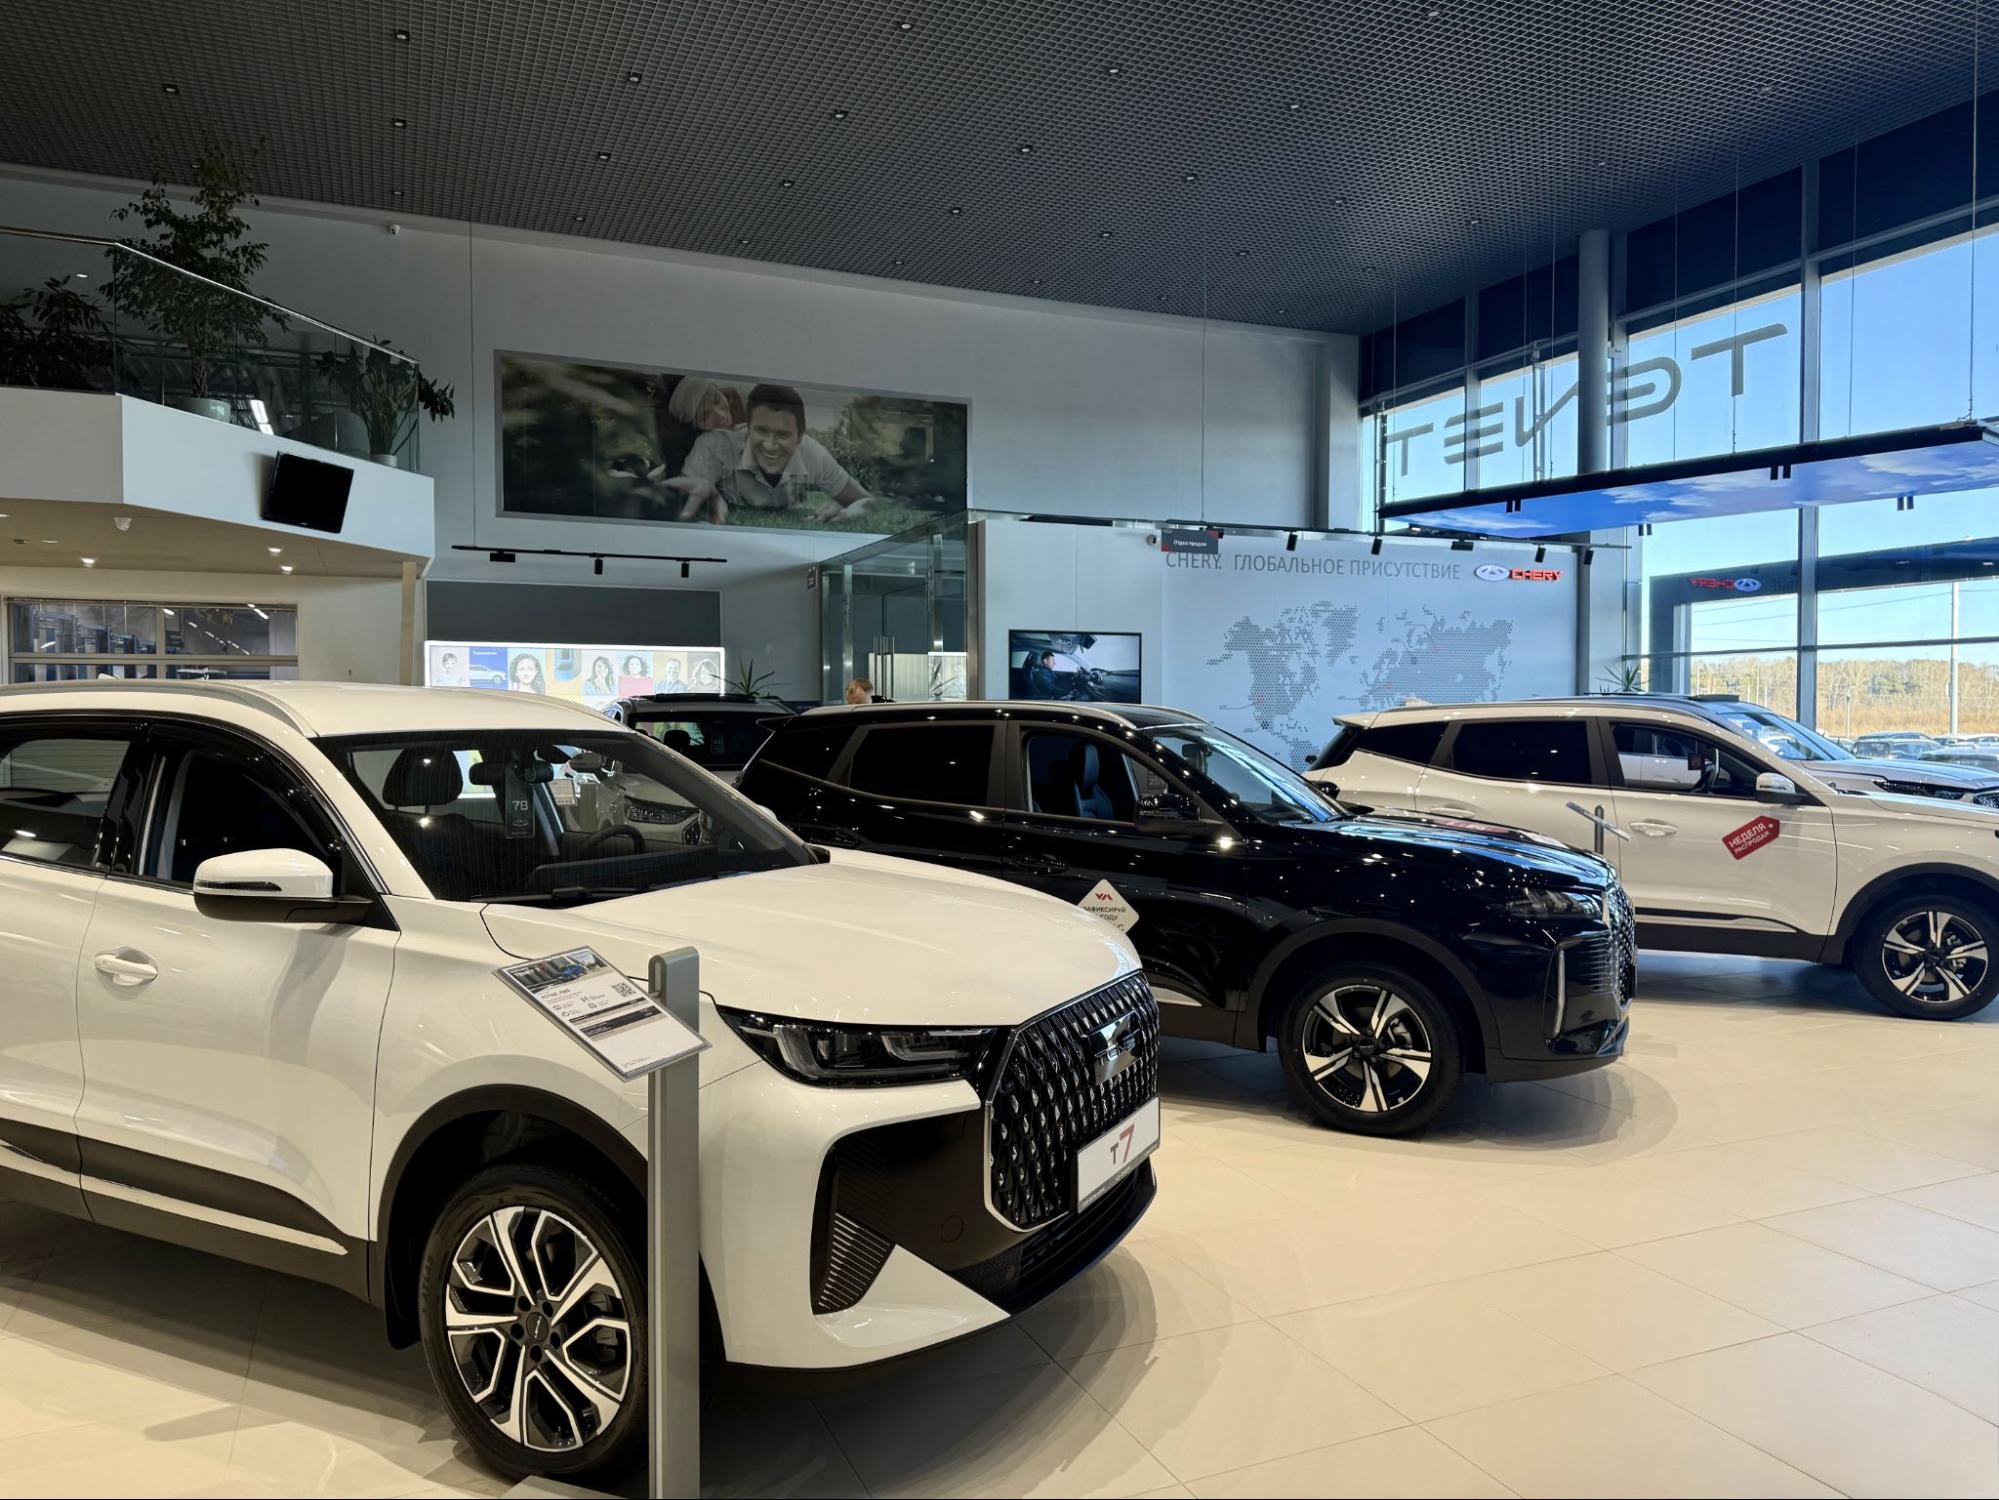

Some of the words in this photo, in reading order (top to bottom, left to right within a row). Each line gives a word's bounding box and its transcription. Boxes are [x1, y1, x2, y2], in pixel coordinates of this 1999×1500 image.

[1234, 554, 1345, 576] ГЛОБАЛЬНОЕ
[1350, 559, 1461, 580] ПРИСУТСТВИЕ
[1511, 568, 1564, 581] CHERY
[1728, 822, 1766, 848] НЕДЕЛЯ
